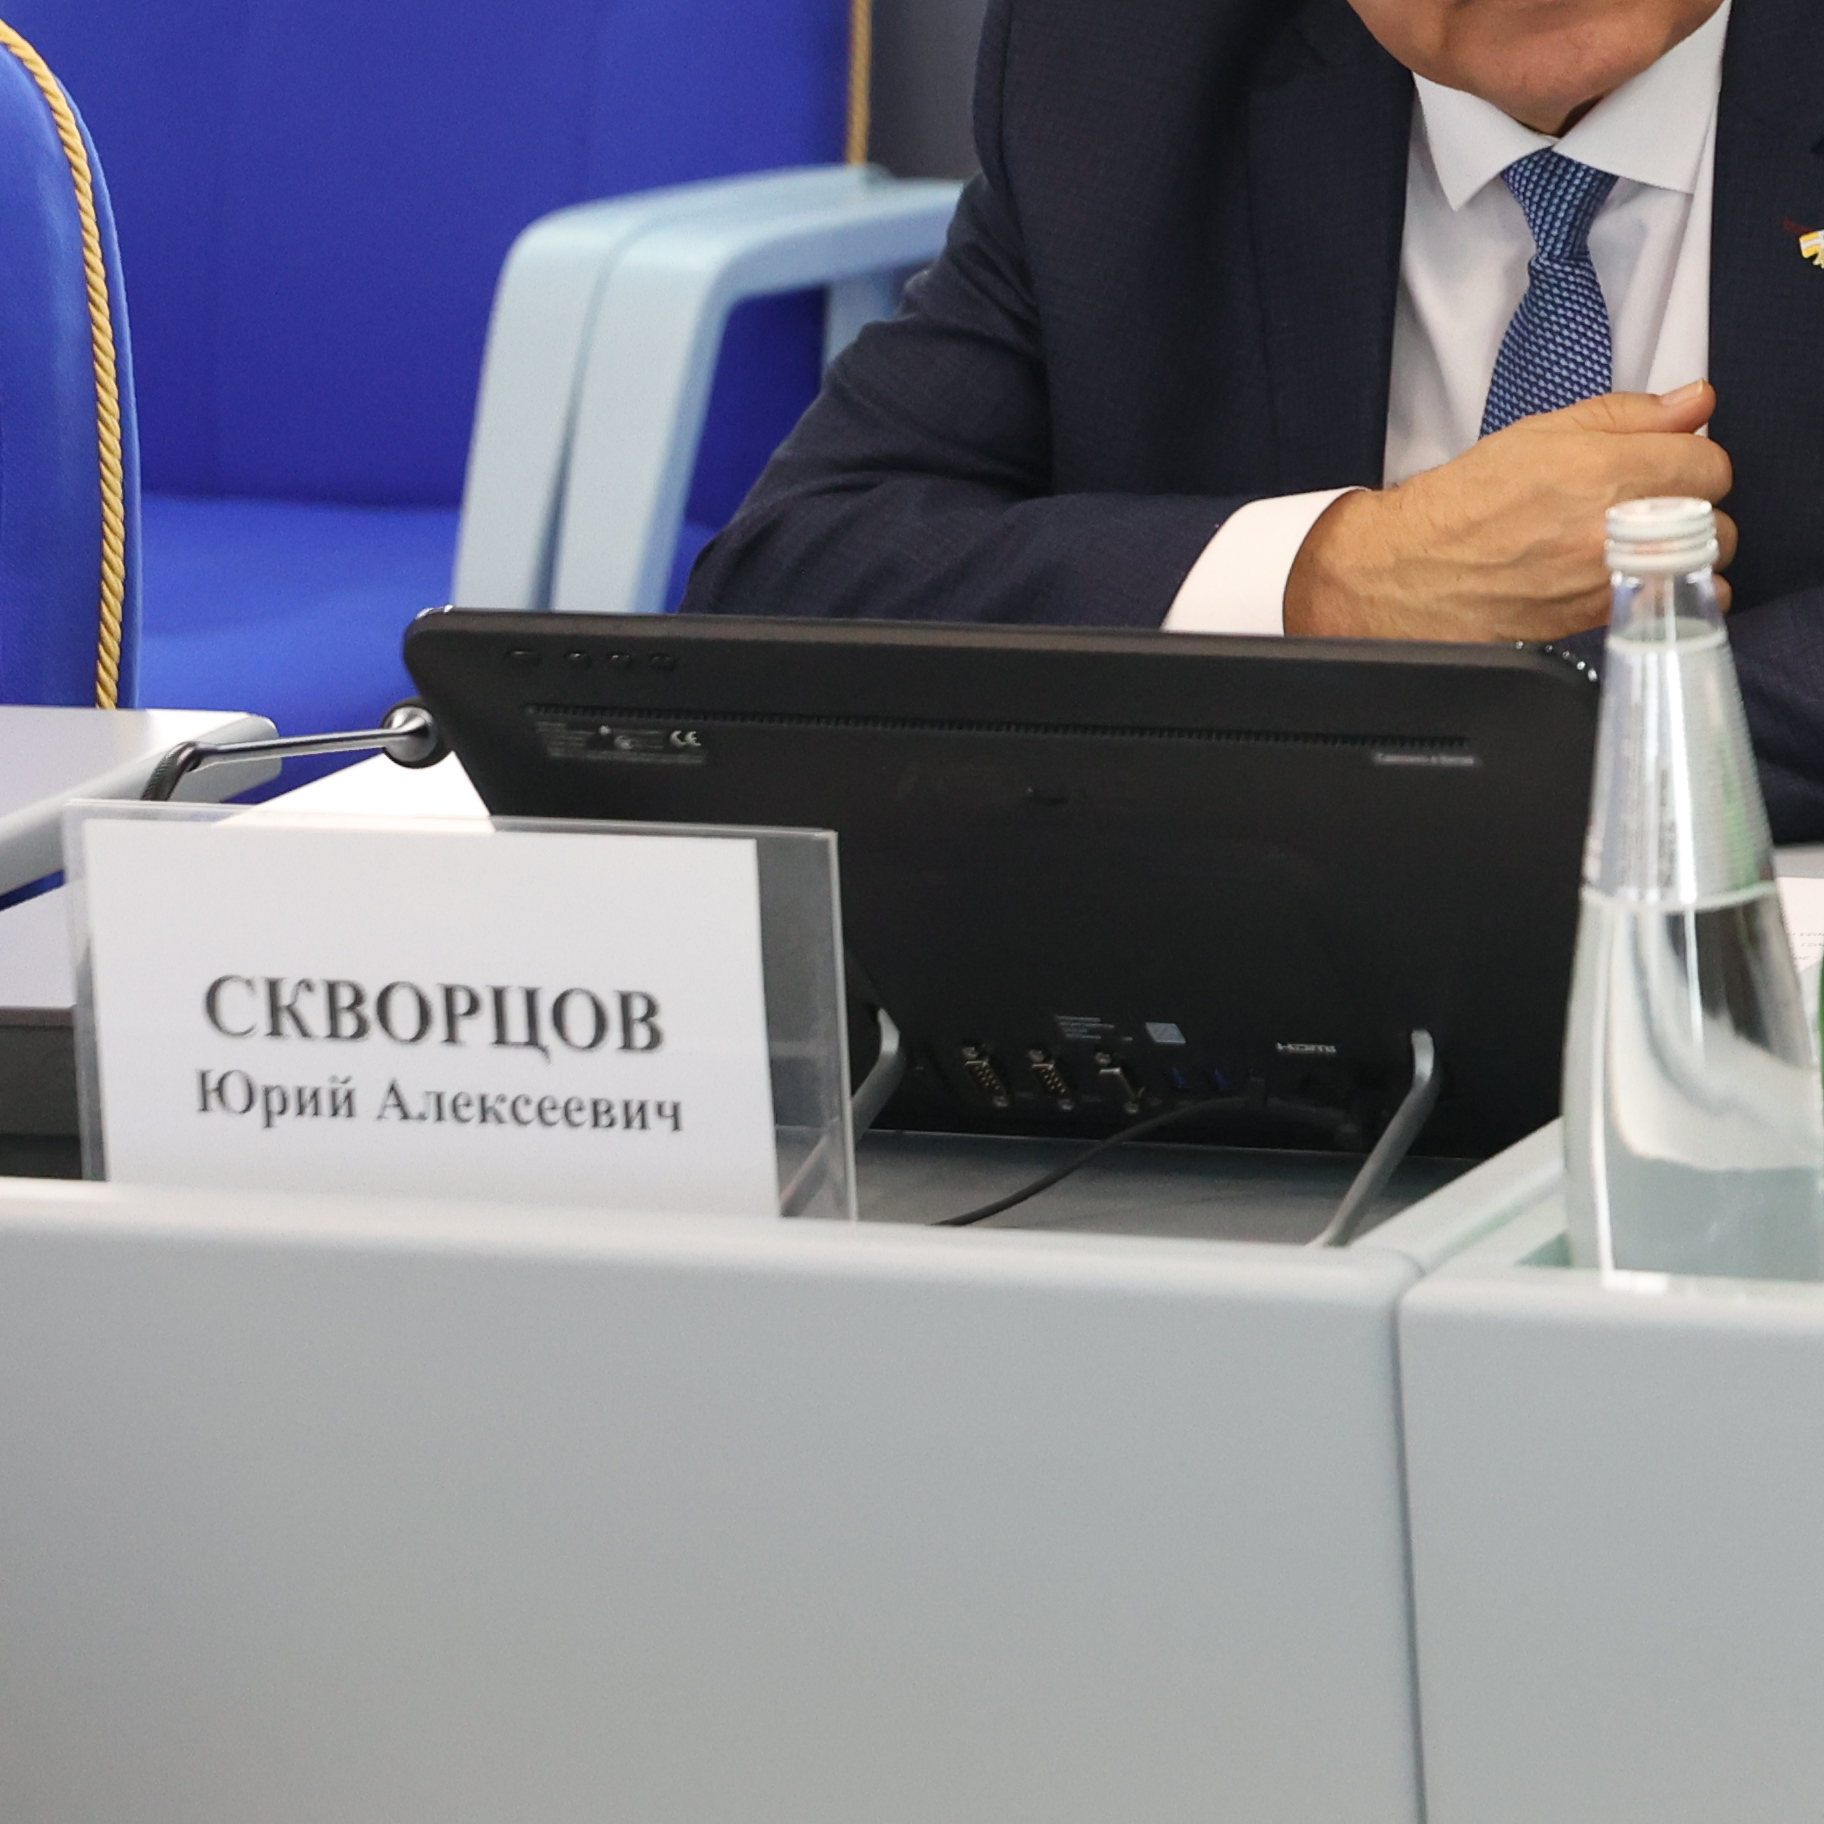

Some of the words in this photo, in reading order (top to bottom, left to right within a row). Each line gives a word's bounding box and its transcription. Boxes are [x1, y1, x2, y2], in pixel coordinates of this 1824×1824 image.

[204, 974, 665, 1060] СКВОРЦОВ
[198, 1069, 357, 1129] Юрий
[376, 1079, 683, 1133] Алексеевич
